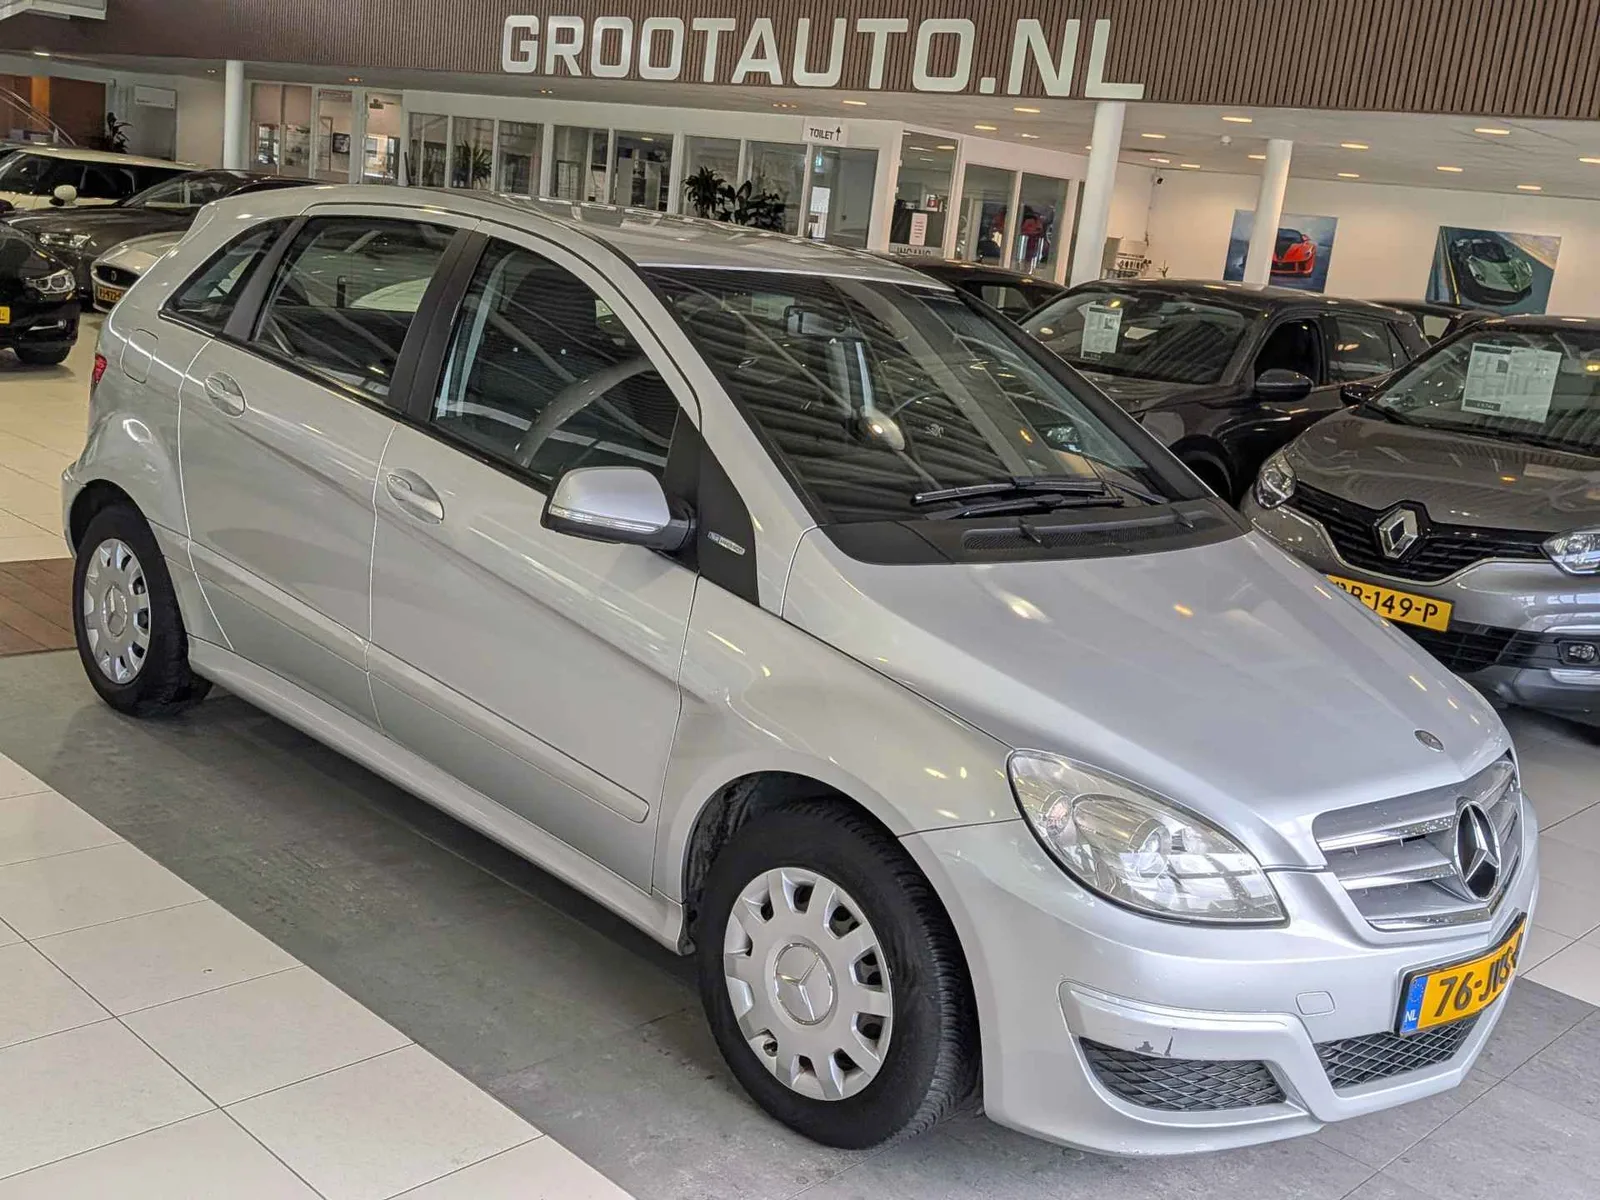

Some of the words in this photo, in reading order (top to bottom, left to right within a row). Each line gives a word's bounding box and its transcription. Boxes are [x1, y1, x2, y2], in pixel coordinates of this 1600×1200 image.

[502, 14, 1145, 100] GROOTAUTO.NL
[810, 127, 835, 141] TOILET
[1404, 1009, 1418, 1022] NL
